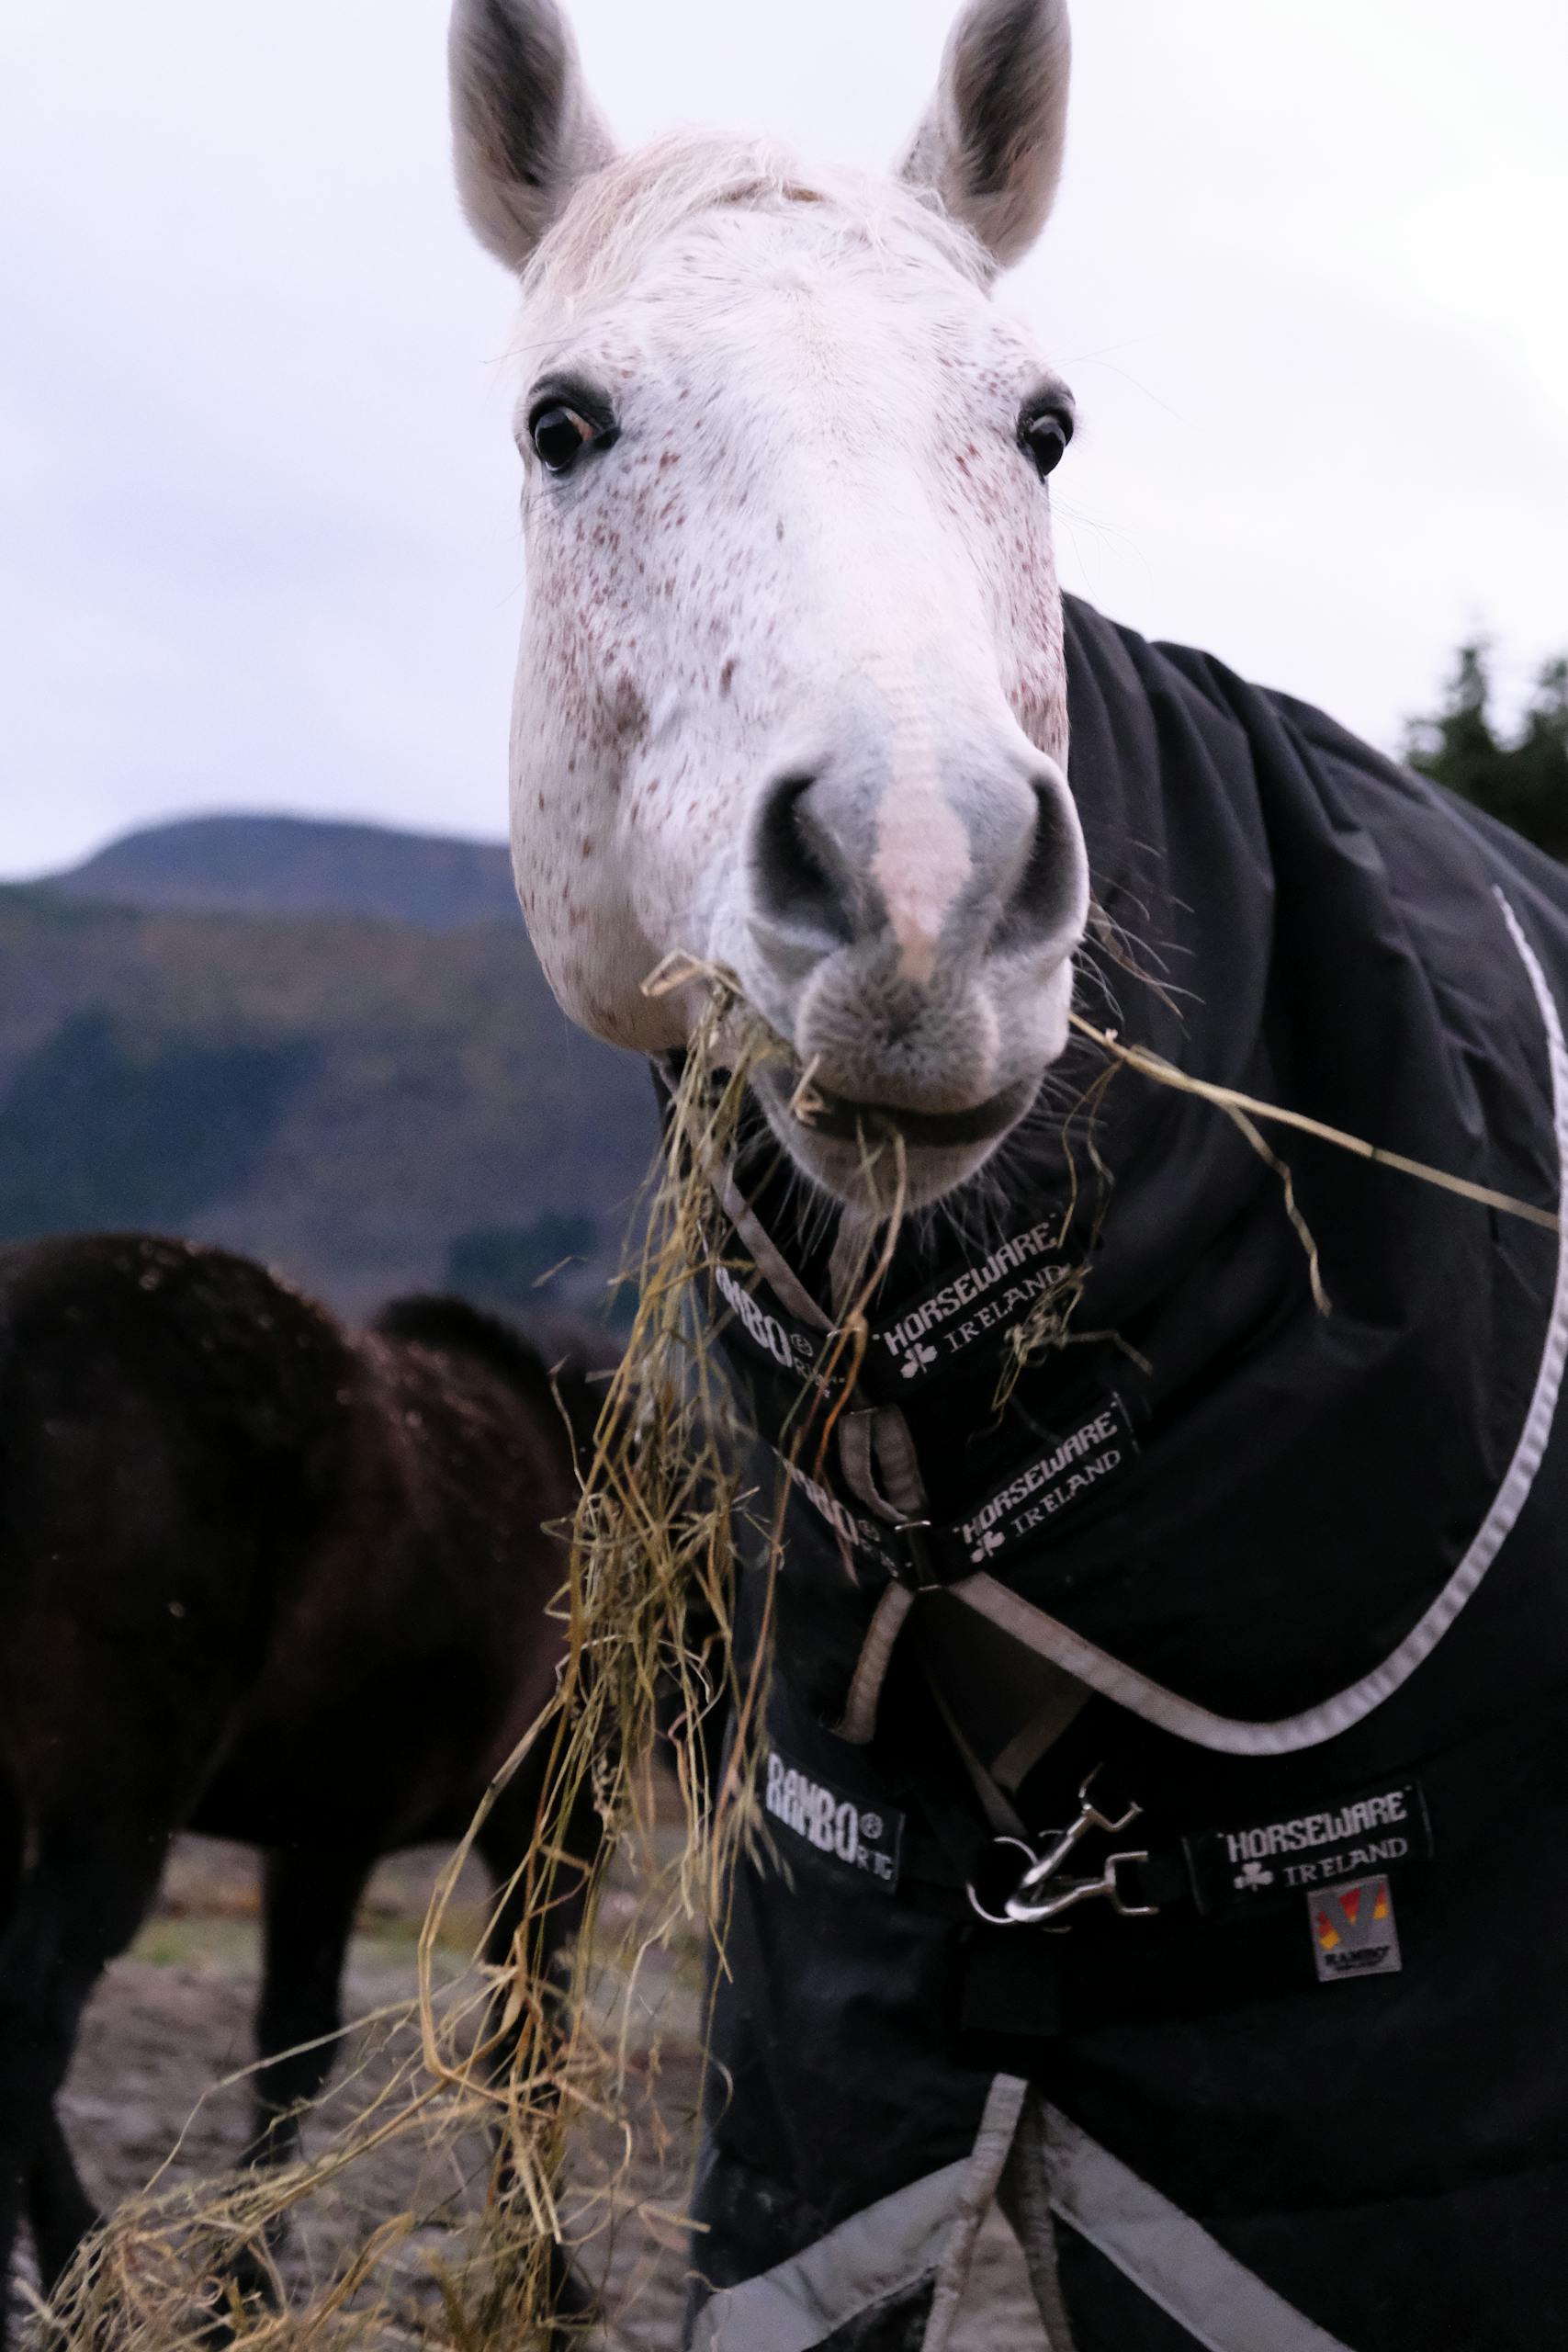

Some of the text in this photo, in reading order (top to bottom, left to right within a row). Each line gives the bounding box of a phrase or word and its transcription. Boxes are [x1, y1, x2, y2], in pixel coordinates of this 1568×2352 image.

[884, 1221, 1058, 1357] HORSEWARE
[942, 1265, 1064, 1354] IRELAND
[961, 1410, 1118, 1544] HORSEWARE
[1012, 1449, 1122, 1539] IRELAND
[766, 1751, 860, 1864] RAMBO
[1226, 1791, 1408, 1863] HORSEWARE
[1282, 1838, 1408, 1888] IRELAND
